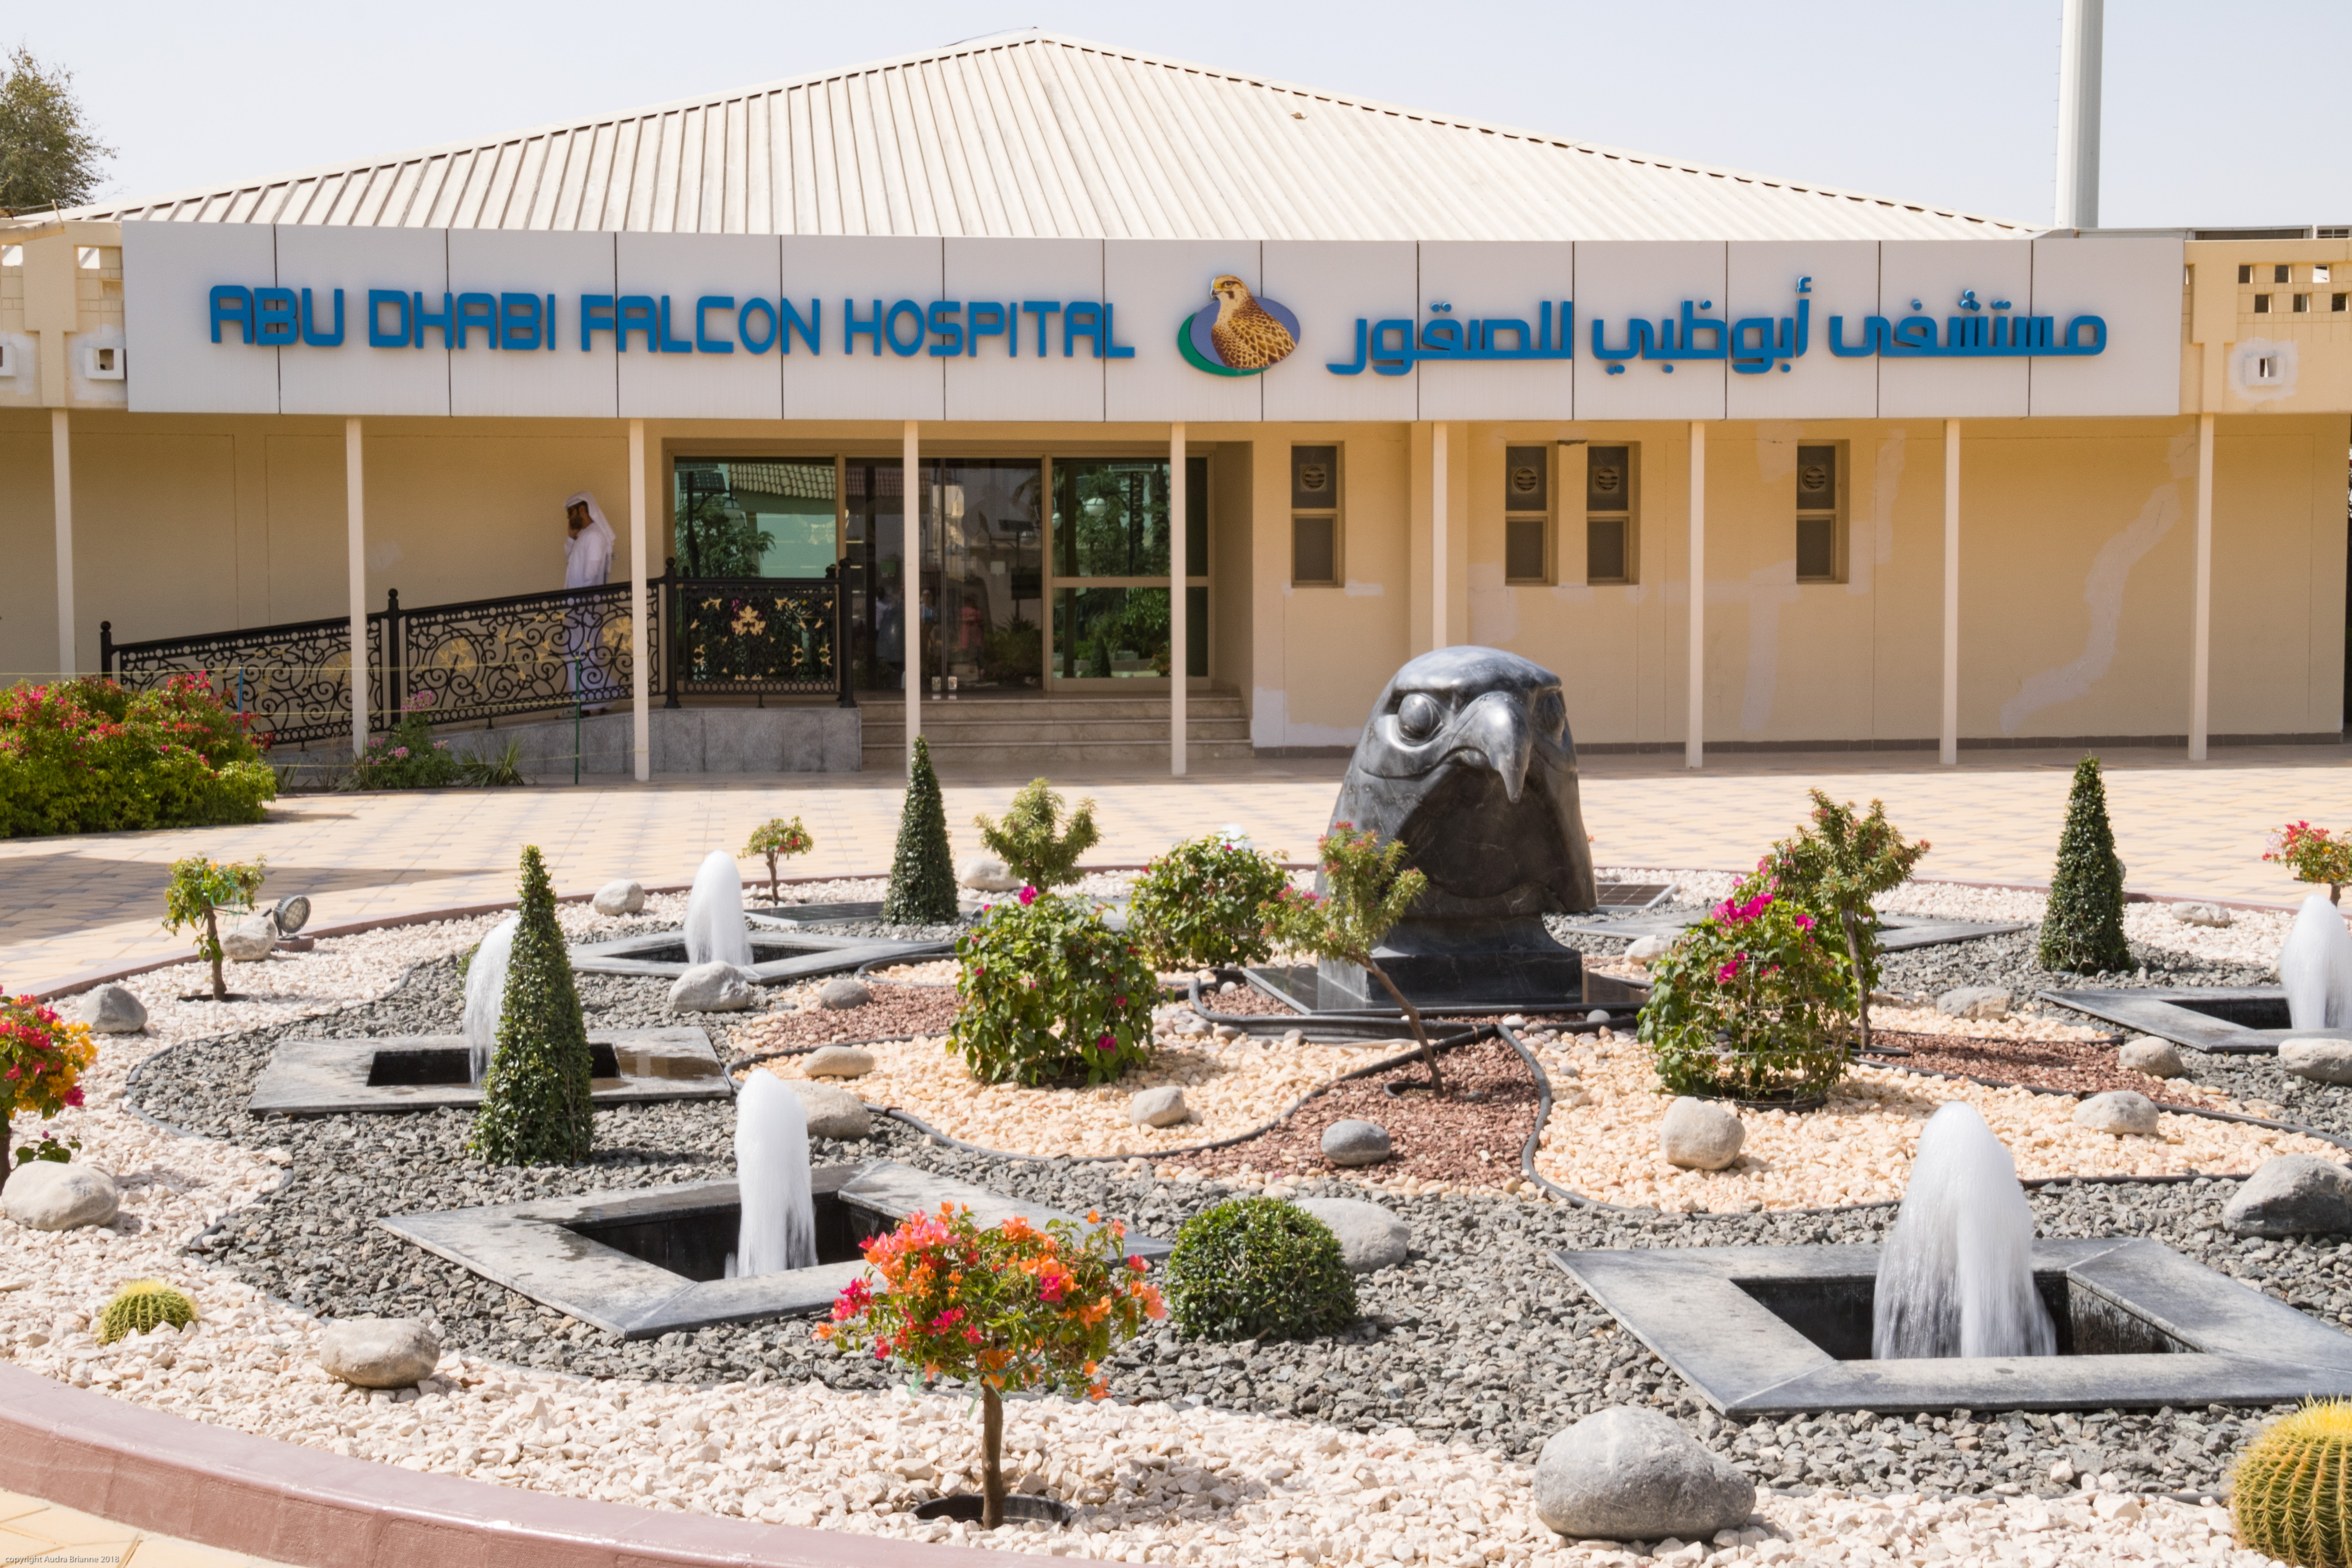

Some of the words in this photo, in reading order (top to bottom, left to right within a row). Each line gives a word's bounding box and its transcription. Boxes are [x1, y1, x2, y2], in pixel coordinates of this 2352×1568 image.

[209, 285, 344, 347] ABU
[368, 289, 556, 351] DHABI
[580, 293, 821, 355] FALCON
[844, 298, 1135, 358] HOSPITAL
[1326, 300, 1573, 376] للصقور
[1828, 289, 2107, 357] مستشفى
